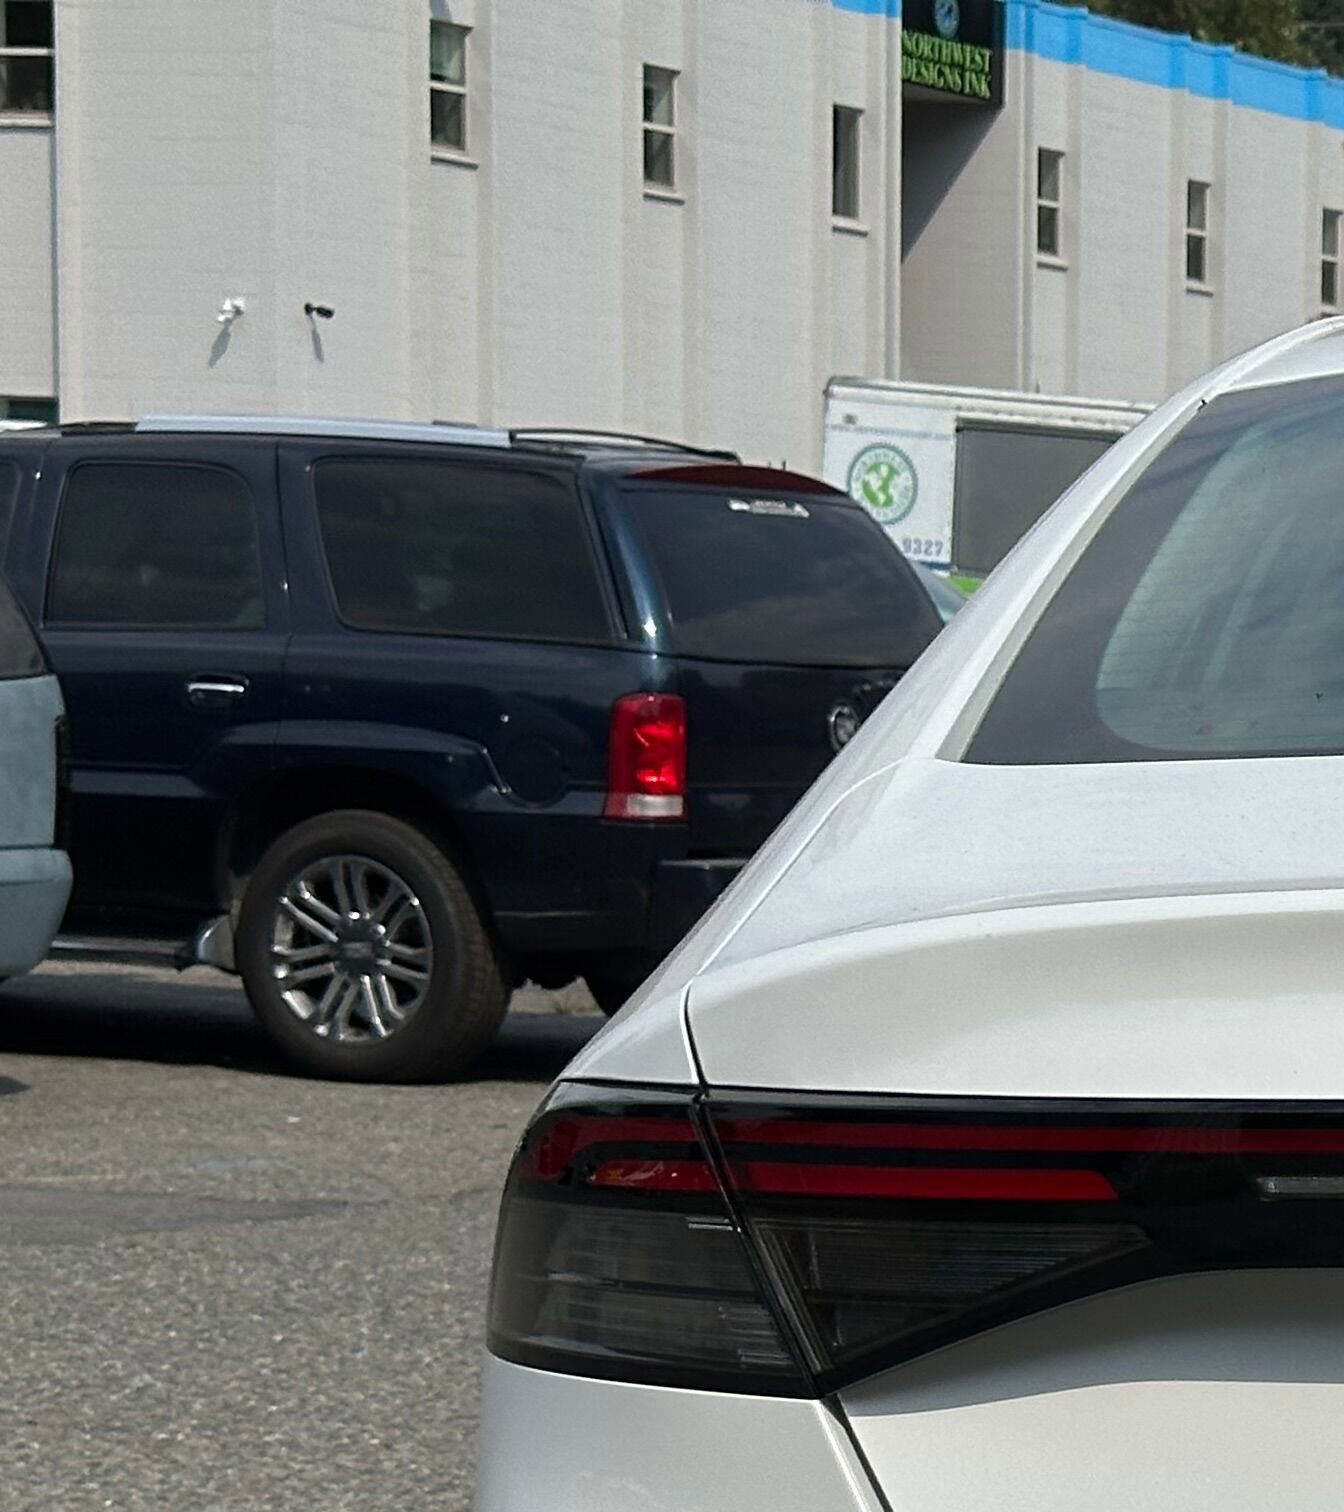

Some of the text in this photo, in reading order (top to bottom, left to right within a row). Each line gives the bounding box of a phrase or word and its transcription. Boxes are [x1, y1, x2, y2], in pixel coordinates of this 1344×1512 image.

[902, 30, 992, 73] NORTHWEST
[902, 55, 991, 98] DESIGNS INK
